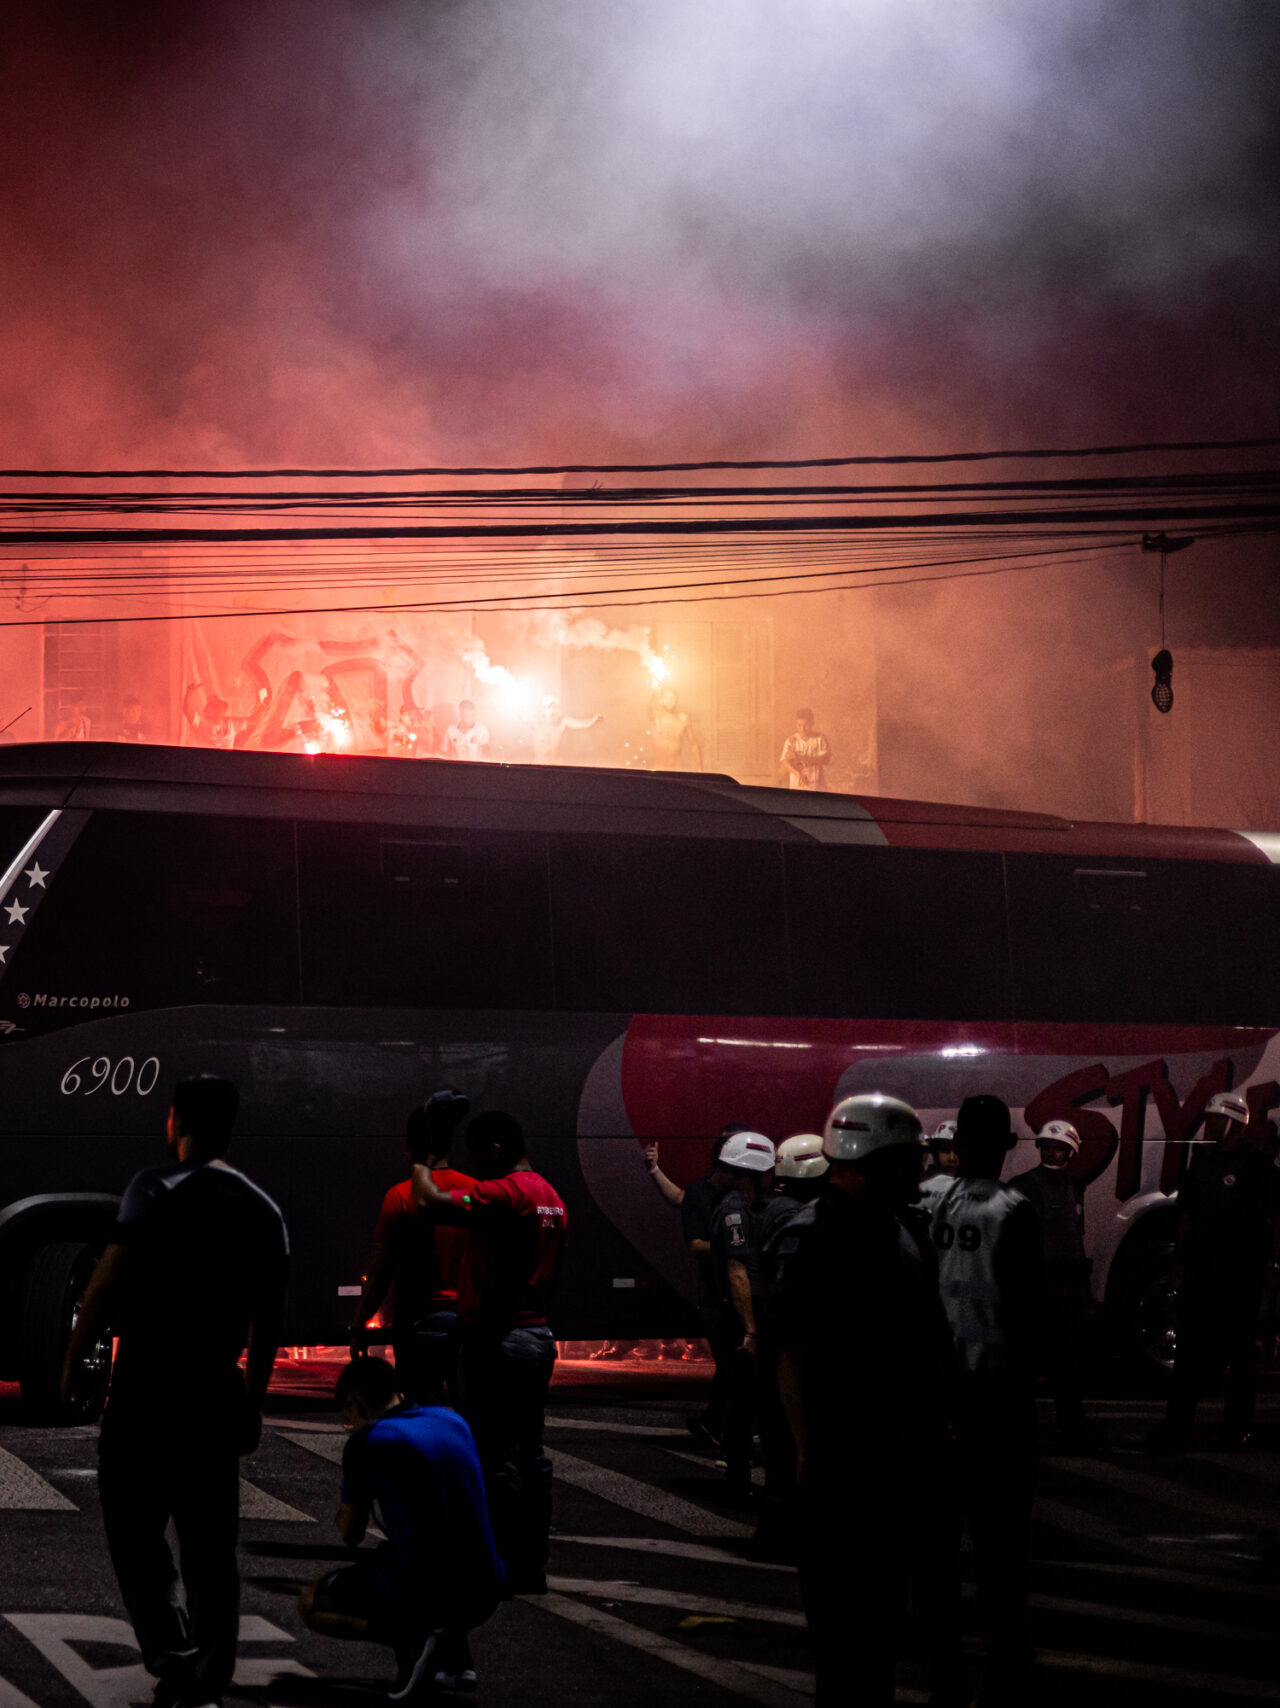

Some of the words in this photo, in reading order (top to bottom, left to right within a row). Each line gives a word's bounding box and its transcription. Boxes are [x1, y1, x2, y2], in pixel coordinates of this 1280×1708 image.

[33, 993, 130, 1010] Marcopolo
[60, 1055, 161, 1097] 6900
[933, 1223, 982, 1252] 09
